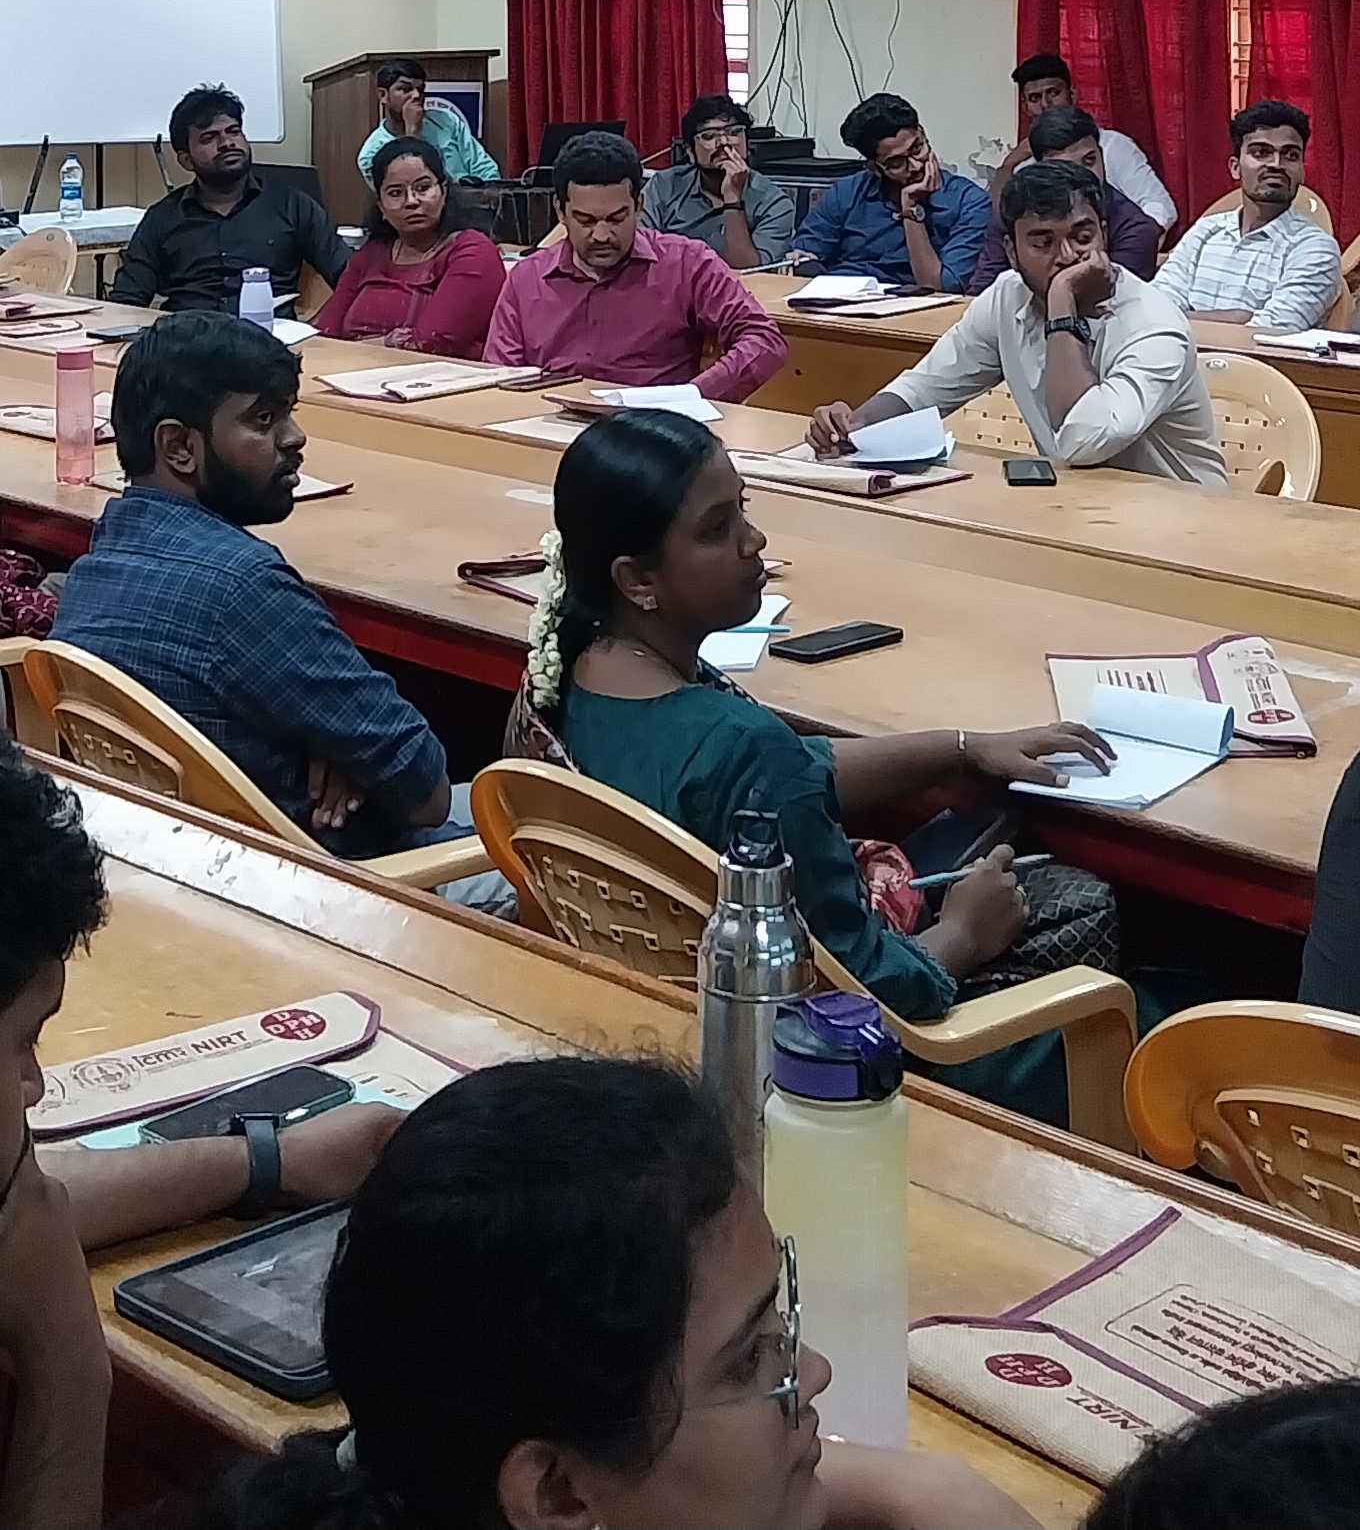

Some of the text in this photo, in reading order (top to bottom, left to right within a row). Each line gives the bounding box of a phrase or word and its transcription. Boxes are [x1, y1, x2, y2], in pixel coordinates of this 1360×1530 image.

[265, 1014, 321, 1034] DPH
[191, 1030, 249, 1054] NIRT
[1066, 1396, 1140, 1430] NIRT
